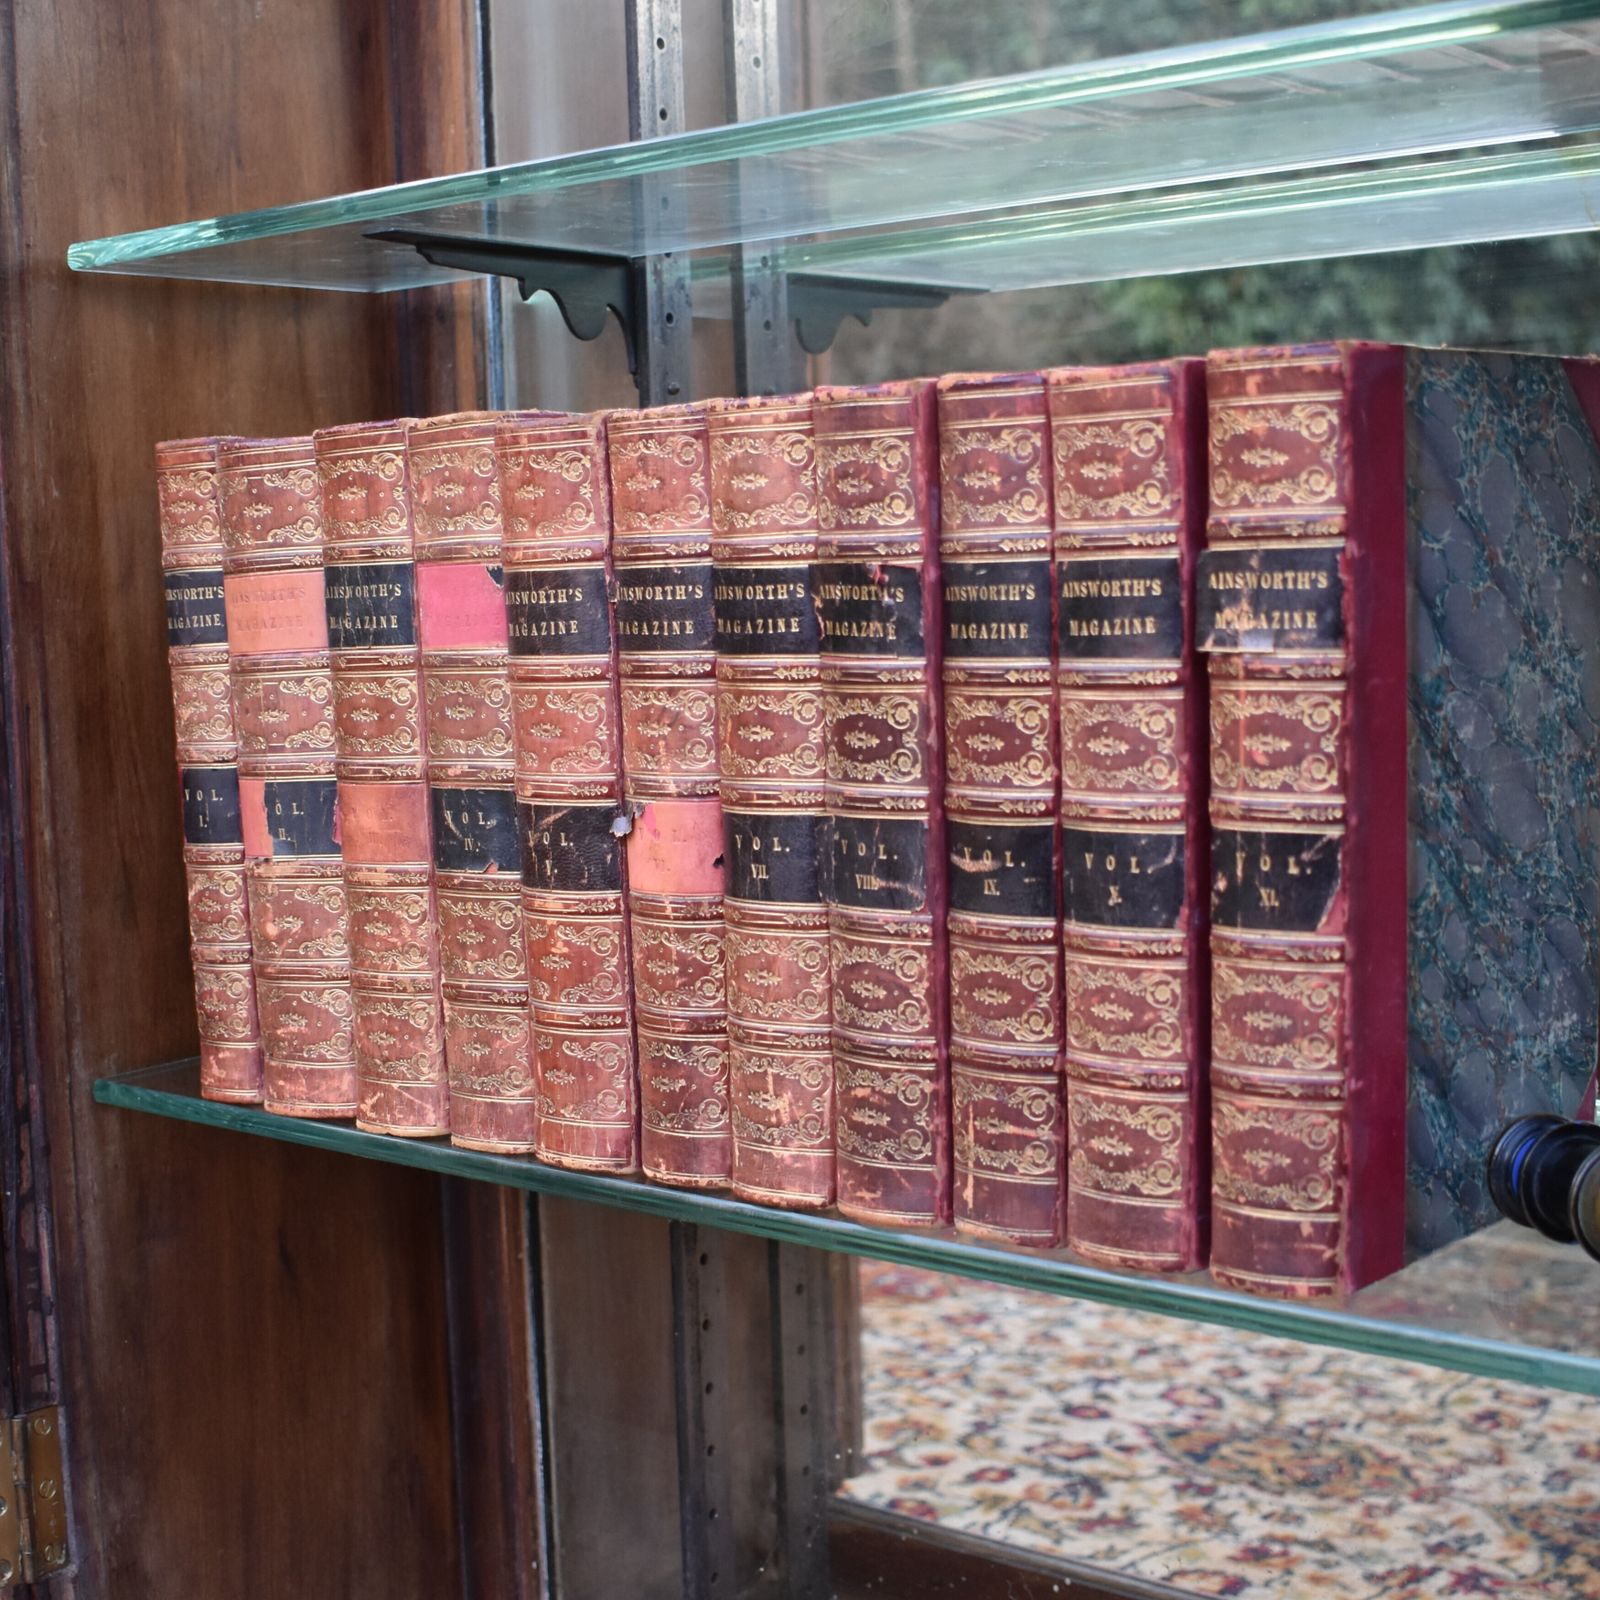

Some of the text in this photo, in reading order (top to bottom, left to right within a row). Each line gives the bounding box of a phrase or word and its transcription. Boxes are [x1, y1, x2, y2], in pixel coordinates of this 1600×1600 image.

[1062, 578, 1163, 598] AINSWORTH'S
[1208, 570, 1329, 590] AINSWORTH'S
[325, 583, 402, 598] AINSWORTH'S
[616, 585, 704, 601] AINSWORTH'S
[714, 583, 805, 600] AINSWORTH'S
[945, 584, 1036, 601] AINSWORTH'S
[329, 615, 398, 629] MAGAZINE
[509, 620, 579, 636] MAGAZINE
[619, 620, 694, 636] MAGAZINE
[717, 617, 800, 634] MAGAZINE
[826, 620, 896, 641] MAGAZINE
[950, 622, 1029, 639] MAGAZINE
[1069, 616, 1157, 637] MAGAZINE
[735, 834, 790, 852] VOL.
[841, 839, 898, 860] VOL.
[1085, 852, 1153, 874] VOL.
